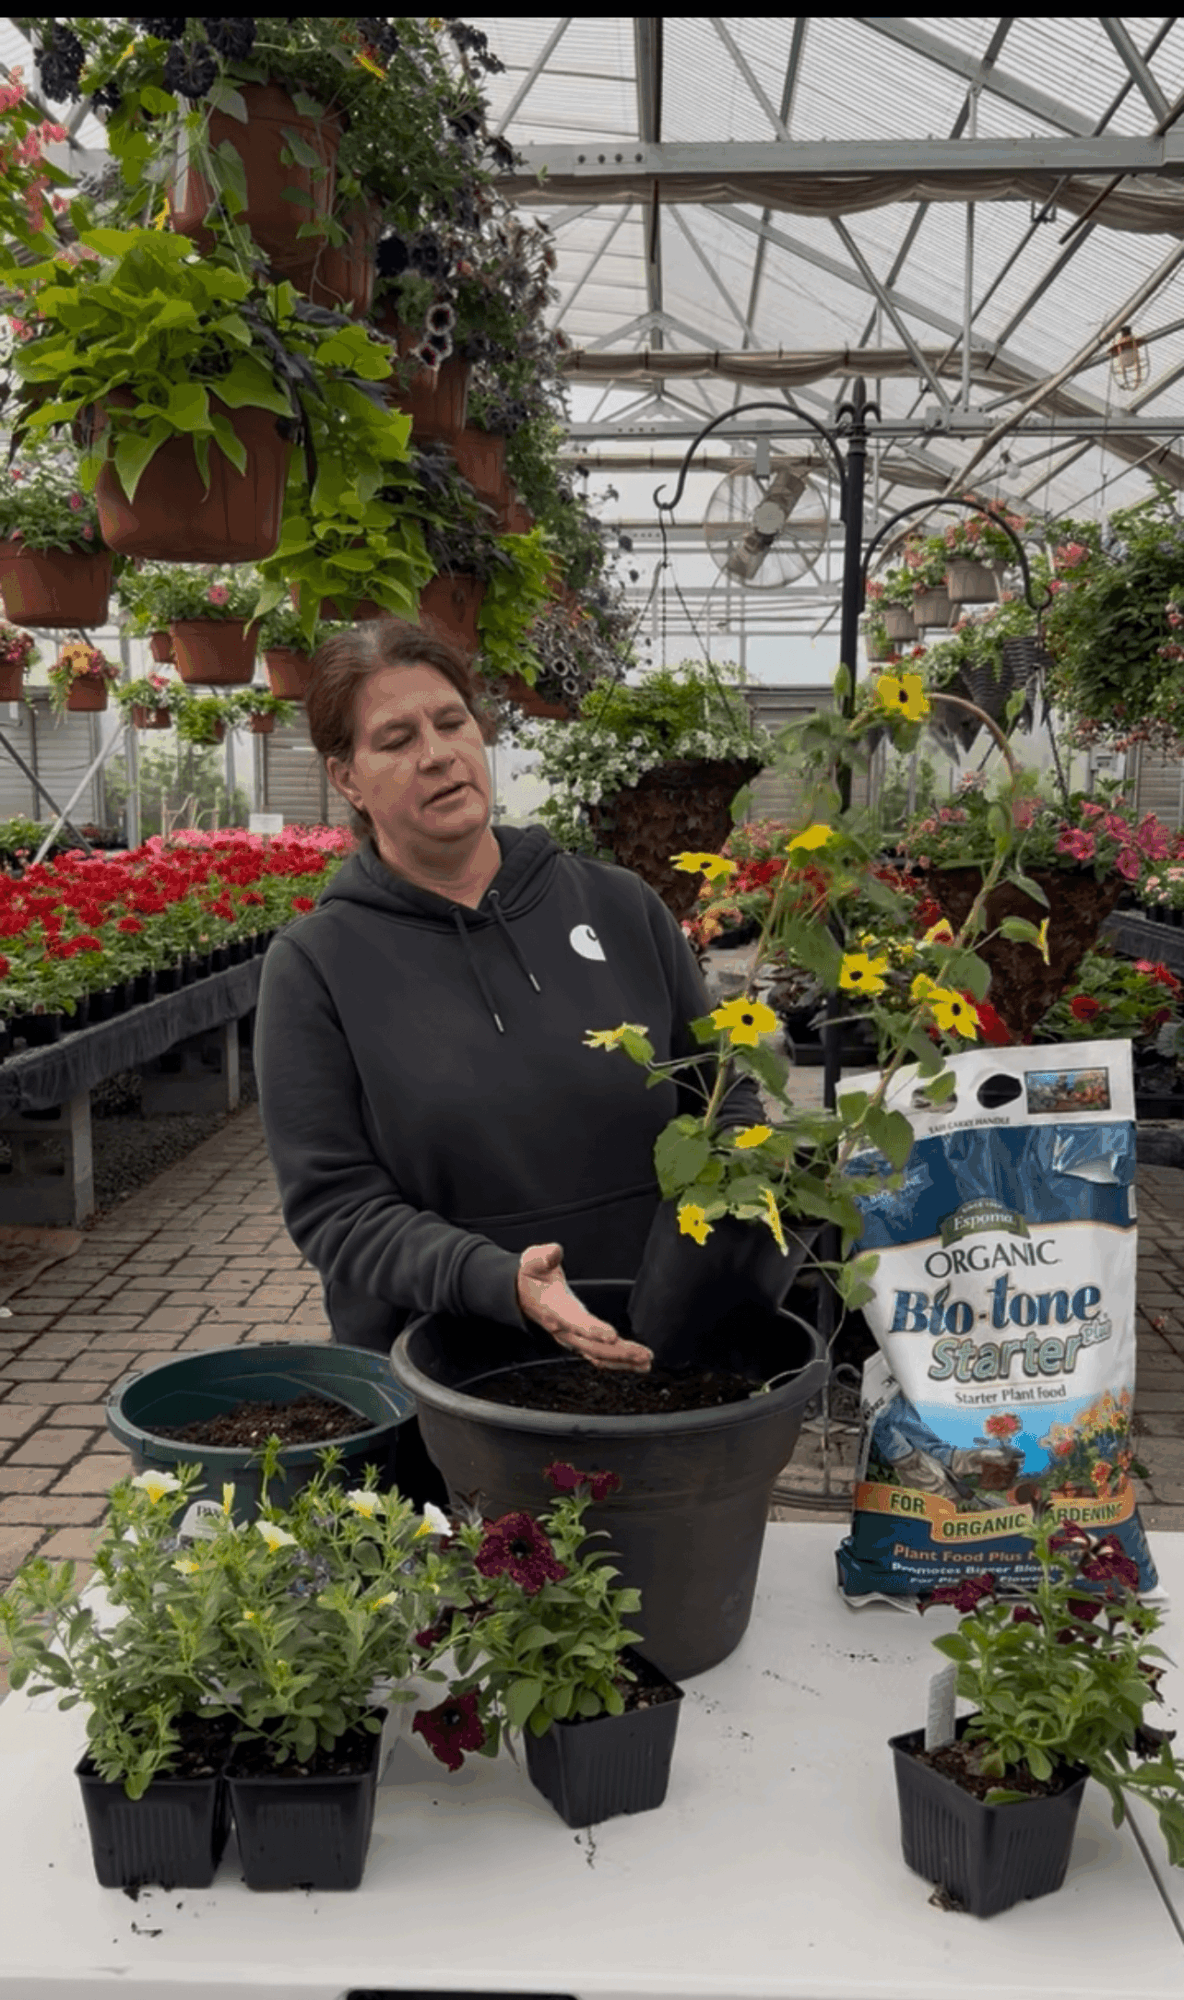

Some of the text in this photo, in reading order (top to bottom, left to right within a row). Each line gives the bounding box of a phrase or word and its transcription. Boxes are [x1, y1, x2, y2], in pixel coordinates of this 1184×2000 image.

[954, 1213, 1014, 1231] Espoma
[925, 1240, 1060, 1278] ORGANIC
[888, 1272, 1102, 1336] Bio-tone
[927, 1331, 1081, 1383] Starter
[955, 1385, 1067, 1405] Starter Plant Food
[890, 1493, 926, 1514] FOR
[942, 1513, 1027, 1538] ORGANIC
[893, 1543, 938, 1561] Plant
[943, 1550, 984, 1562] Food
[989, 1550, 1021, 1562] Plus
